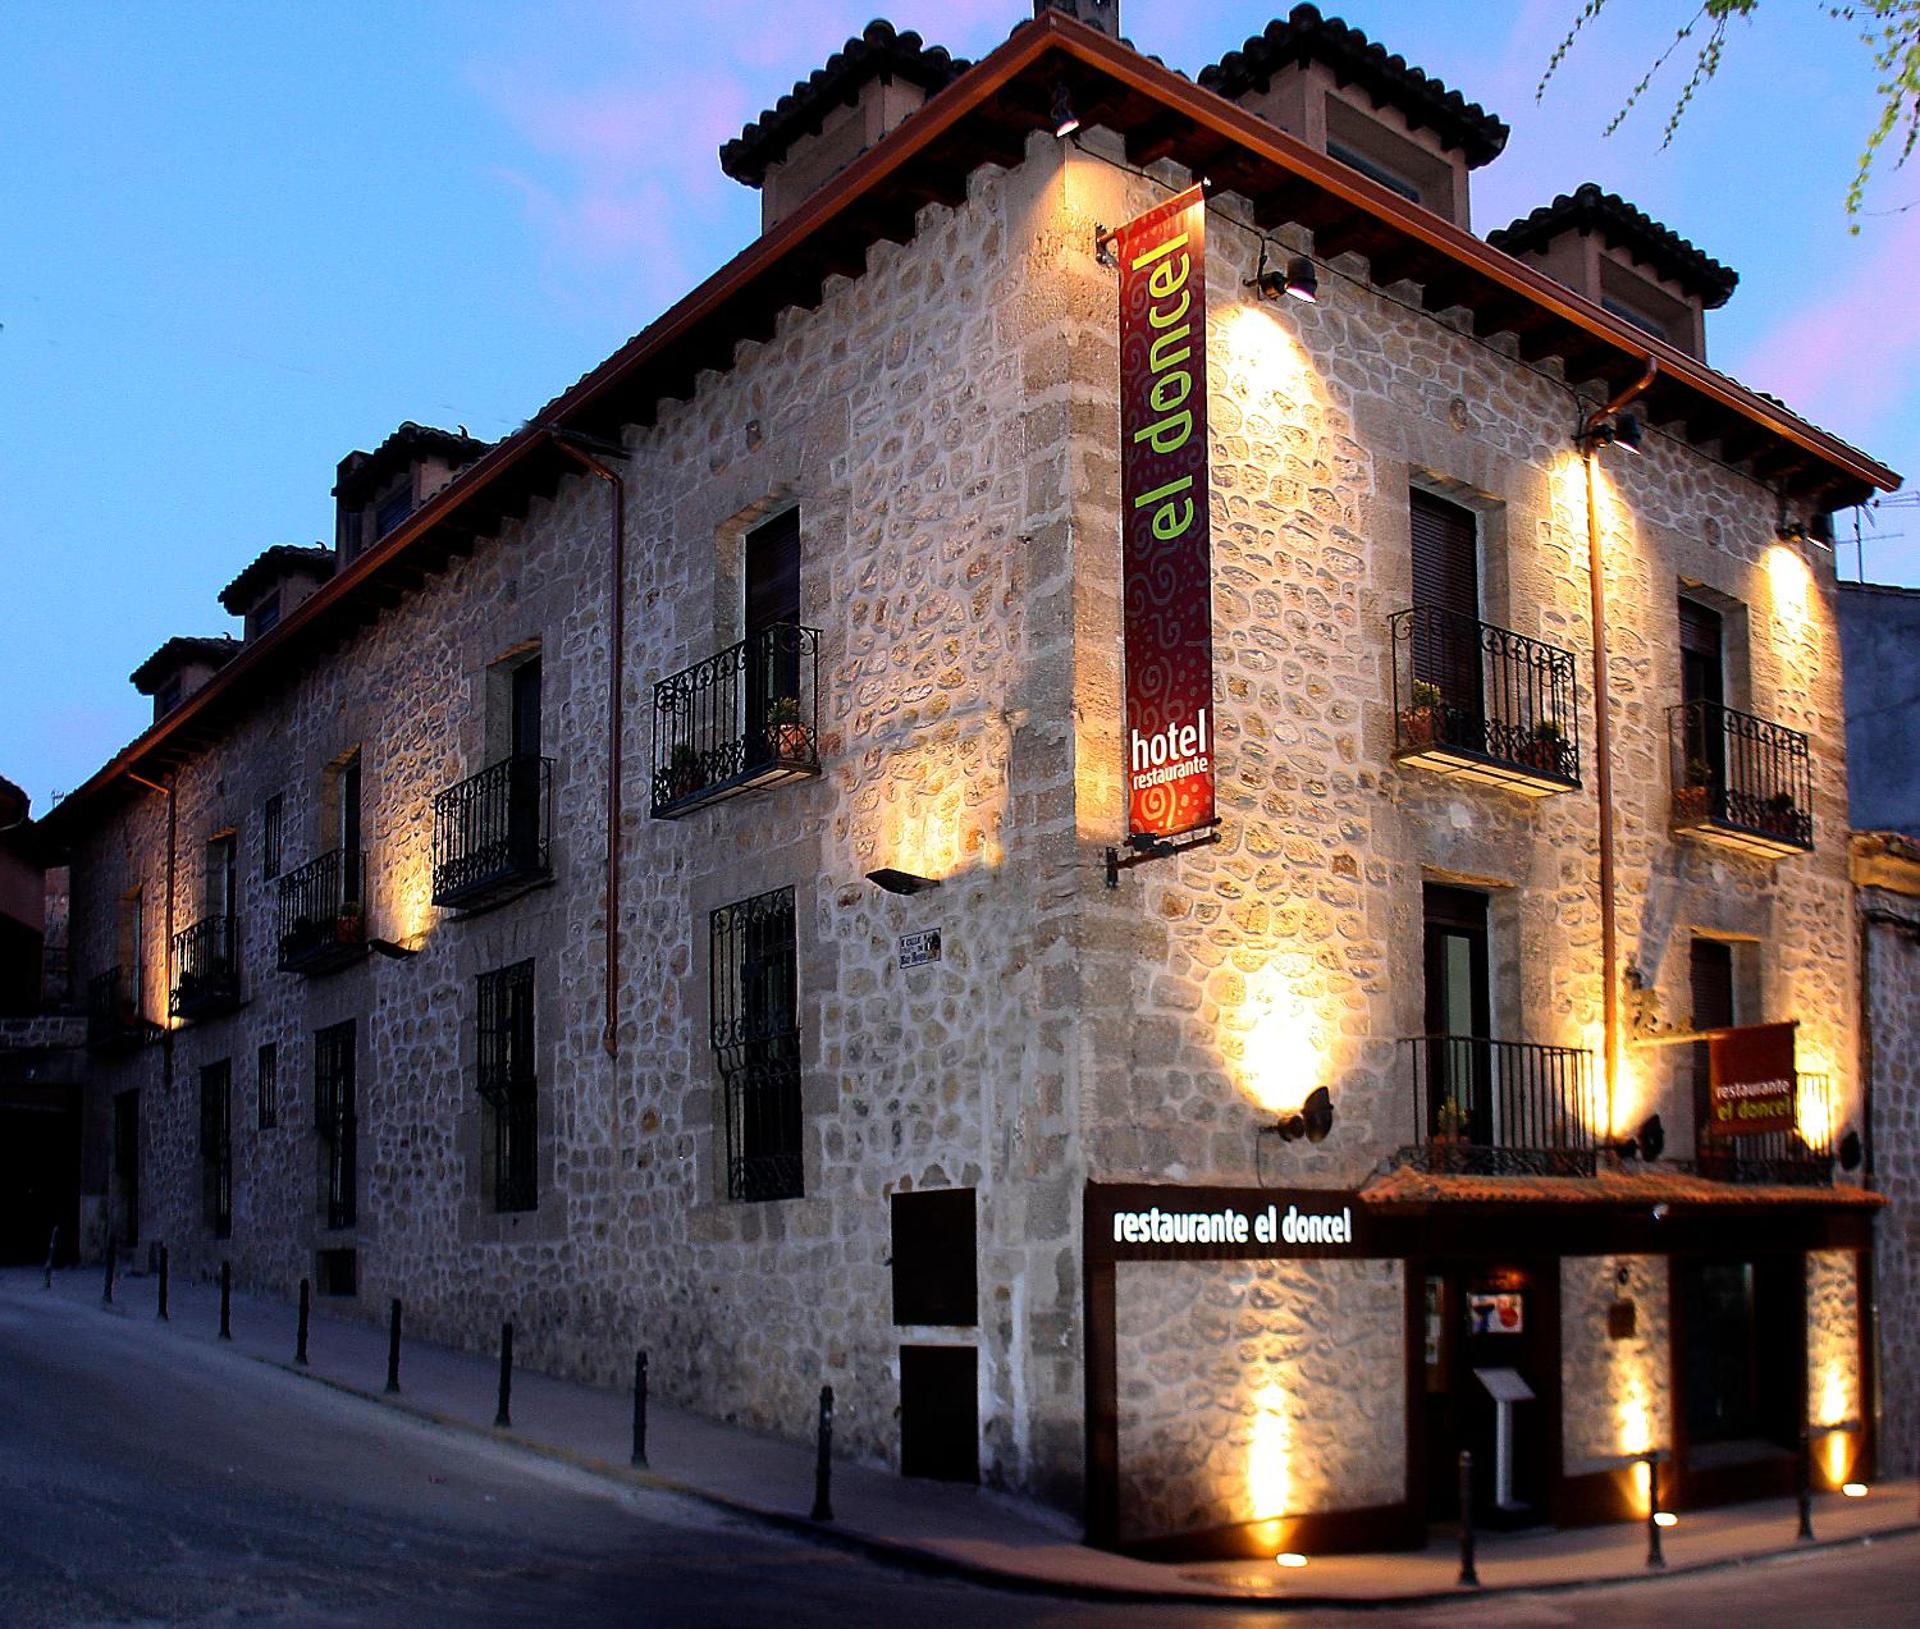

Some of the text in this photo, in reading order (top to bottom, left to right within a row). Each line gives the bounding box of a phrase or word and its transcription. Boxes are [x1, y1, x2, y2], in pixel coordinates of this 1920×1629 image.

[1132, 232, 1194, 541] el doncel
[1131, 708, 1207, 772] hotel
[1133, 755, 1208, 791] restaurante
[1717, 1079, 1790, 1099] restaurante
[1718, 1095, 1791, 1121] el doncel
[1113, 1204, 1352, 1243] restaurante el doncel
